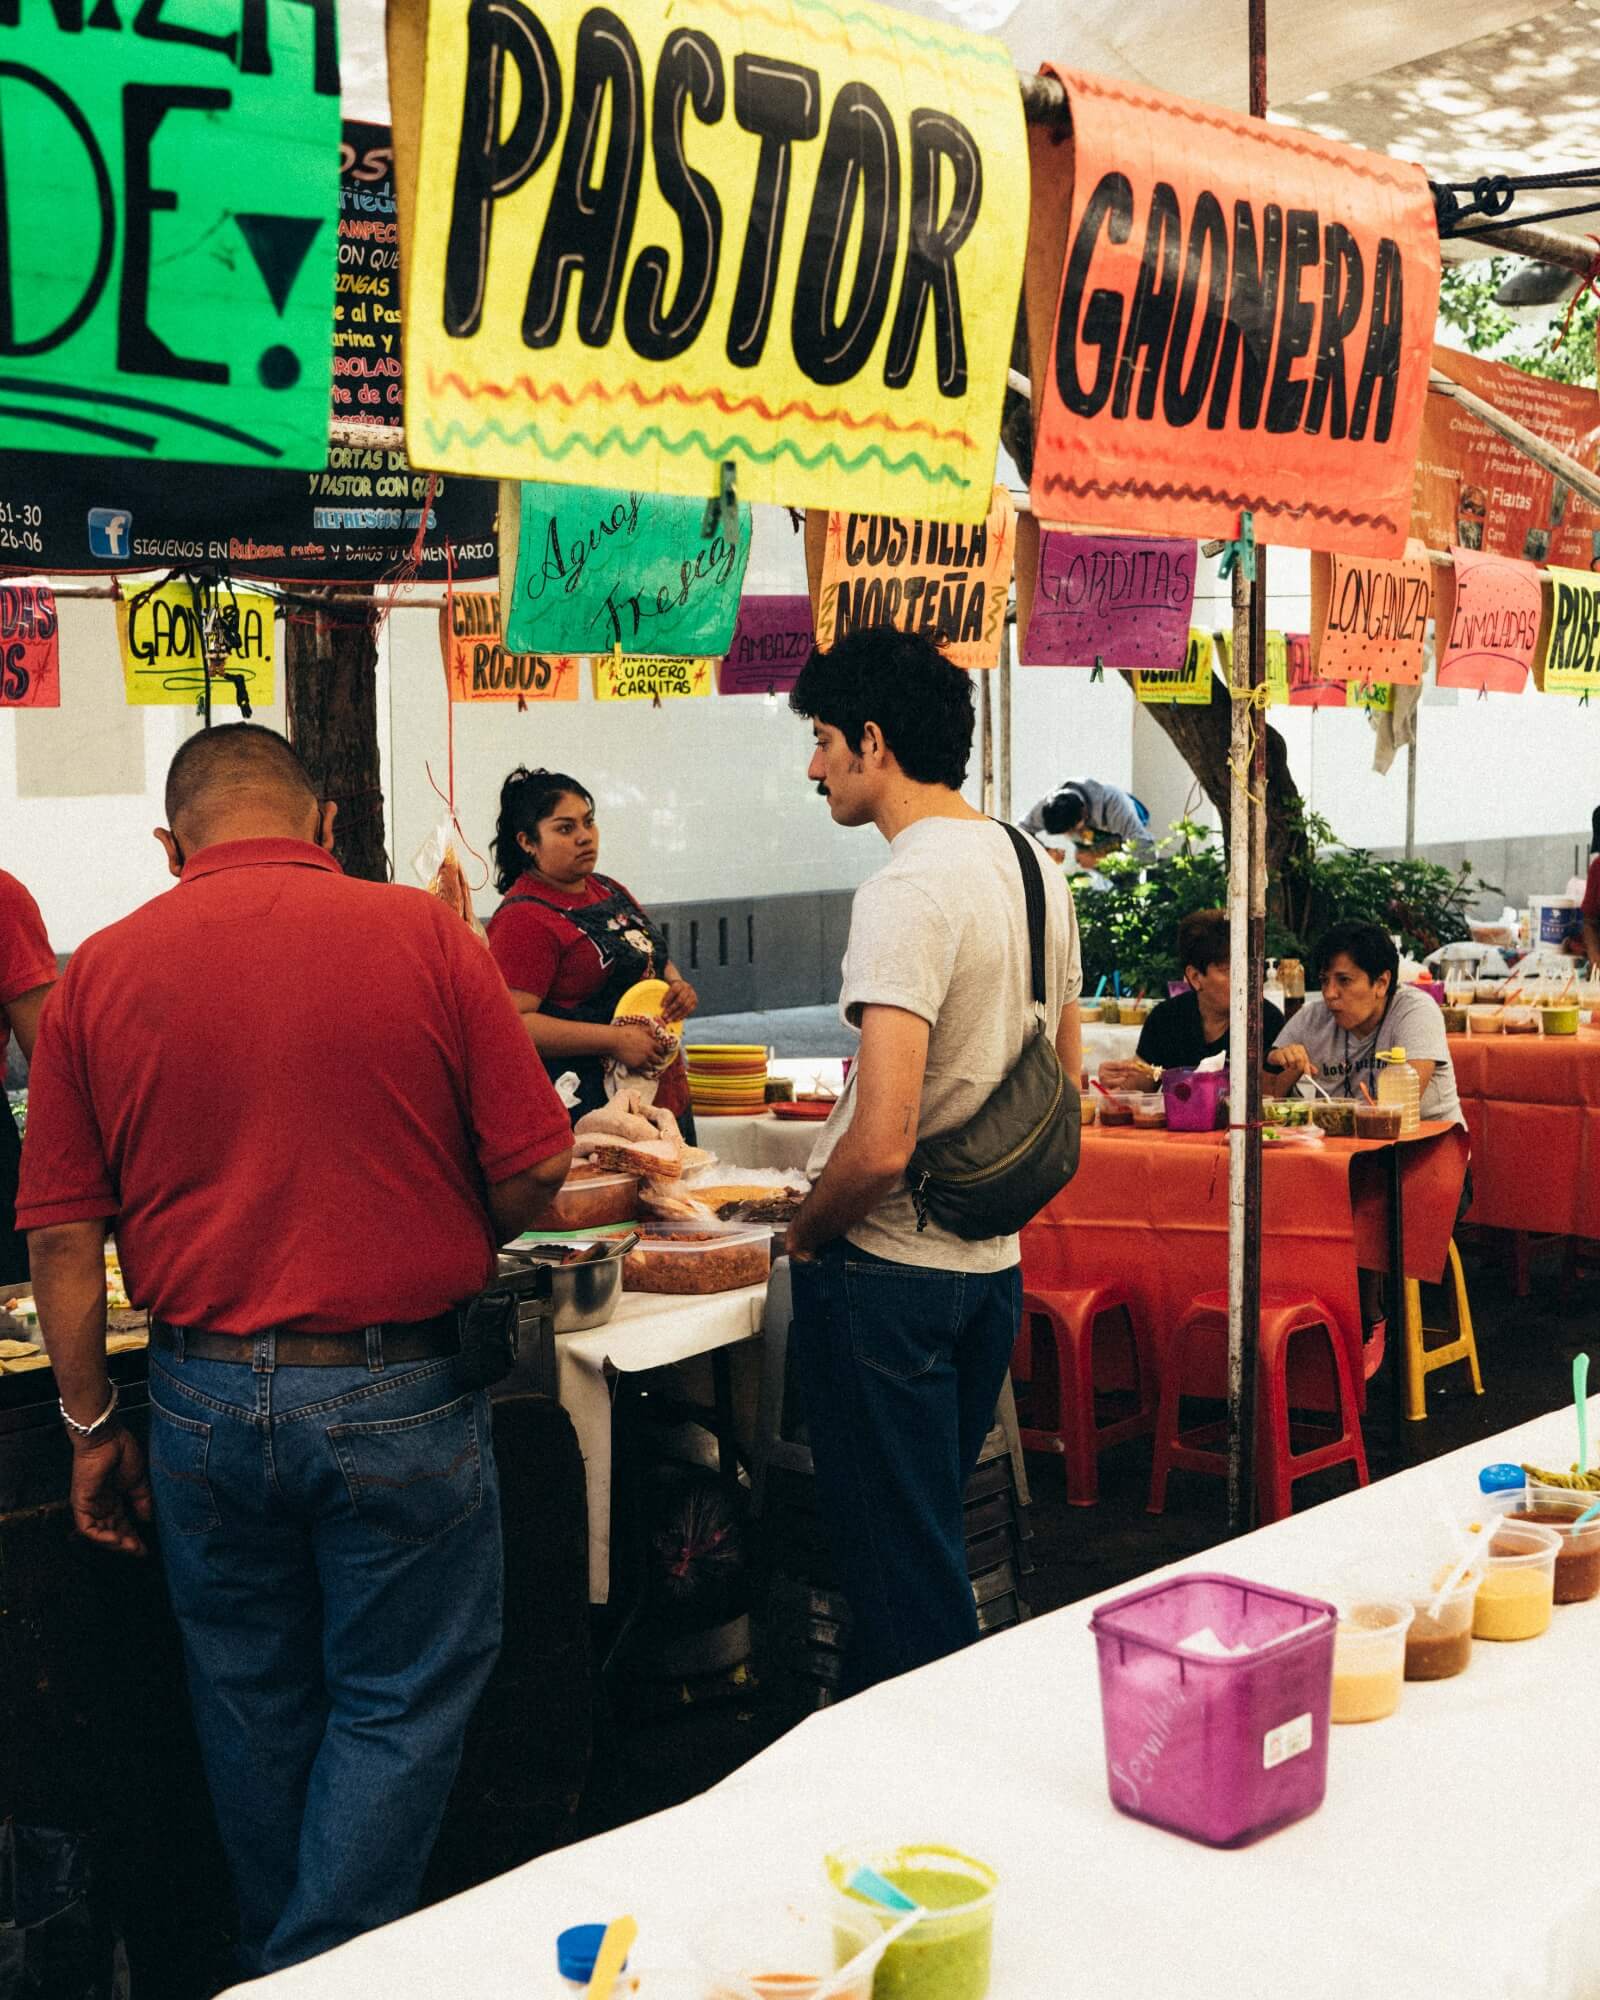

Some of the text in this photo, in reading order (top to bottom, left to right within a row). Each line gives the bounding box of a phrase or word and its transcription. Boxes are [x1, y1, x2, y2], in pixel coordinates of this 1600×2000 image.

[443, 0, 983, 398] PASTOR
[338, 219, 399, 244] AMPEC
[336, 243, 365, 267] ON
[1056, 171, 1404, 444] GAONERA
[328, 447, 383, 470] ORTAS
[320, 474, 373, 496] PASTOR
[376, 475, 408, 497] CON
[133, 538, 204, 558] SIGUENOS
[209, 541, 227, 559] EN
[1040, 532, 1190, 618] GORDITAS
[1327, 553, 1429, 643] LONGANIZA
[1549, 582, 1600, 672] RIBE
[734, 629, 815, 663] AMBAZO
[473, 643, 551, 690] ROJOS
[616, 664, 687, 680] UADERO
[618, 680, 691, 697] CARNITAS
